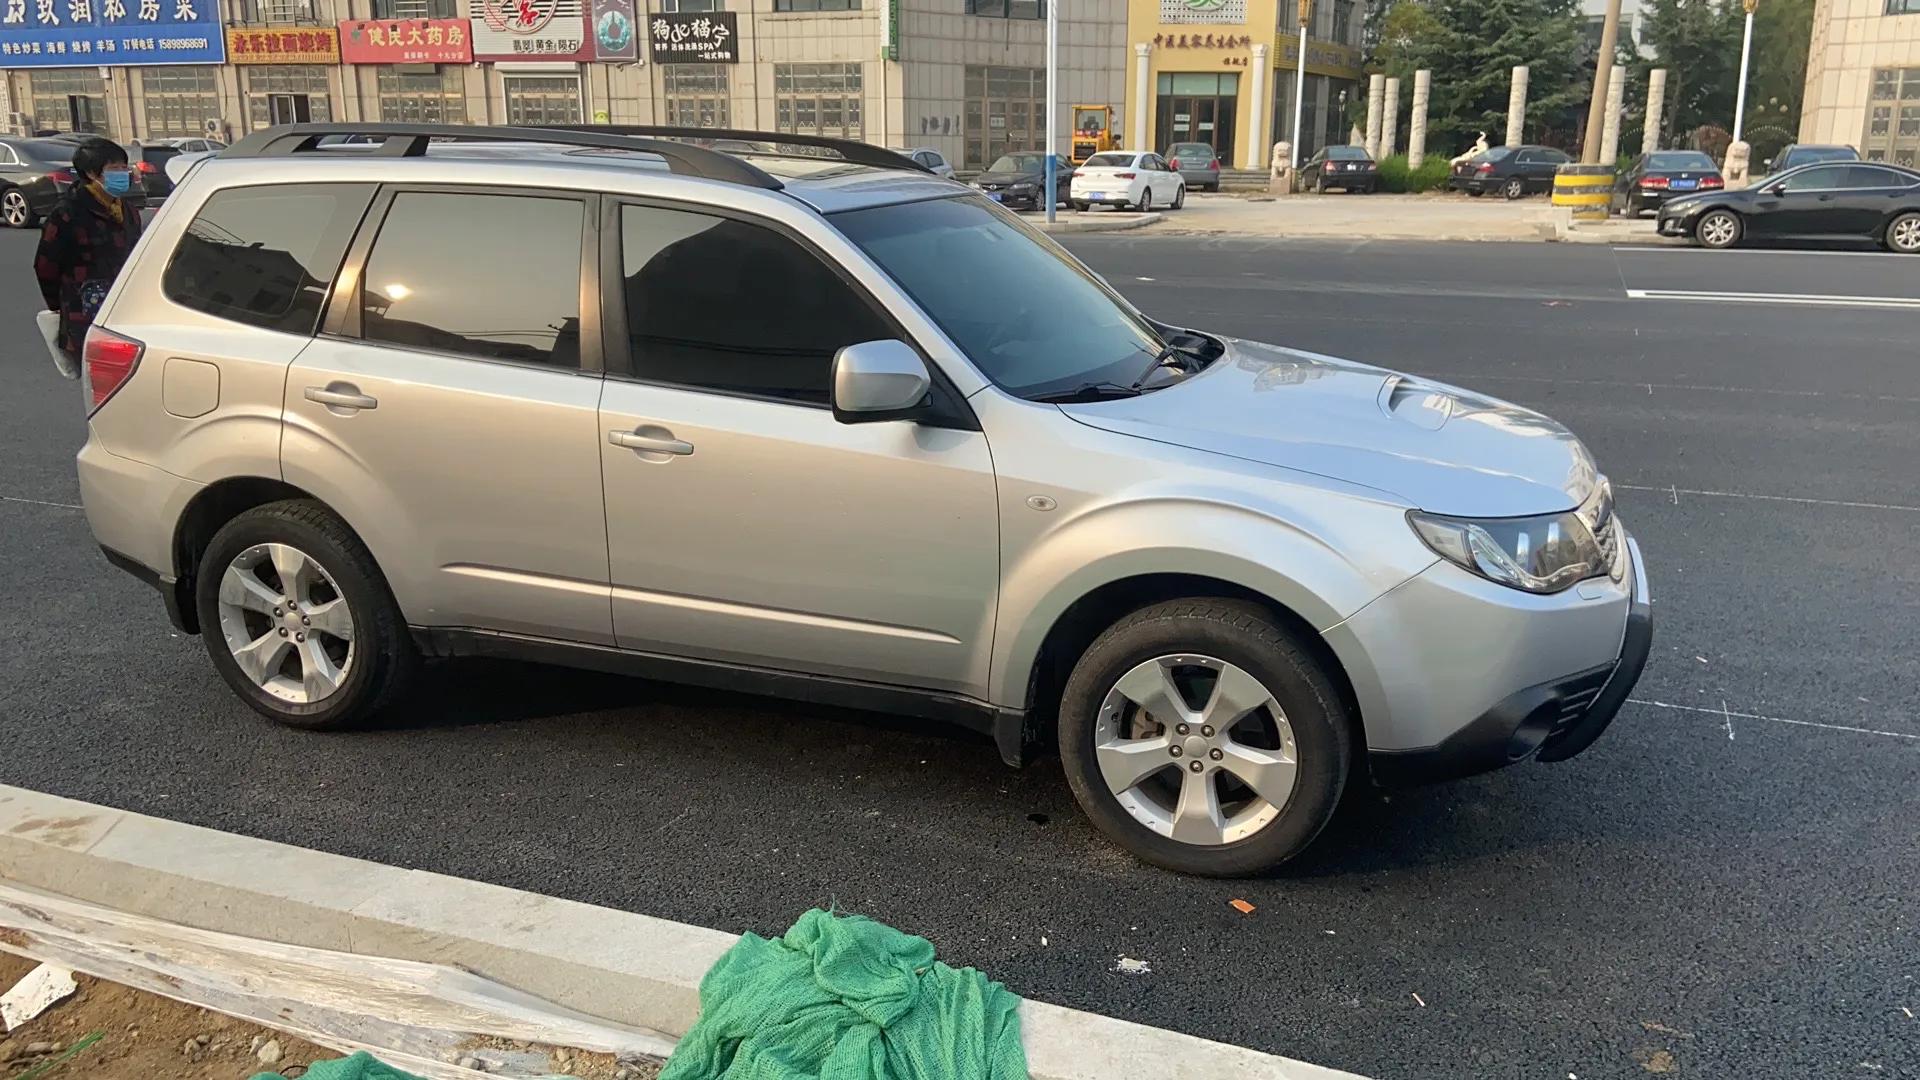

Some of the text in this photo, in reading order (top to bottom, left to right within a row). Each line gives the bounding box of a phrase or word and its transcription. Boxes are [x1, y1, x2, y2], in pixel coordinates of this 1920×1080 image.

[367, 26, 464, 47] 健民大药房
[1153, 33, 1250, 49] 中医美容养生会所
[46, 41, 66, 54] 海鲜
[96, 39, 116, 52] 羊汤
[122, 38, 155, 51] 订餐电话
[536, 39, 553, 51] 黄金
[558, 39, 577, 51] 陨石
